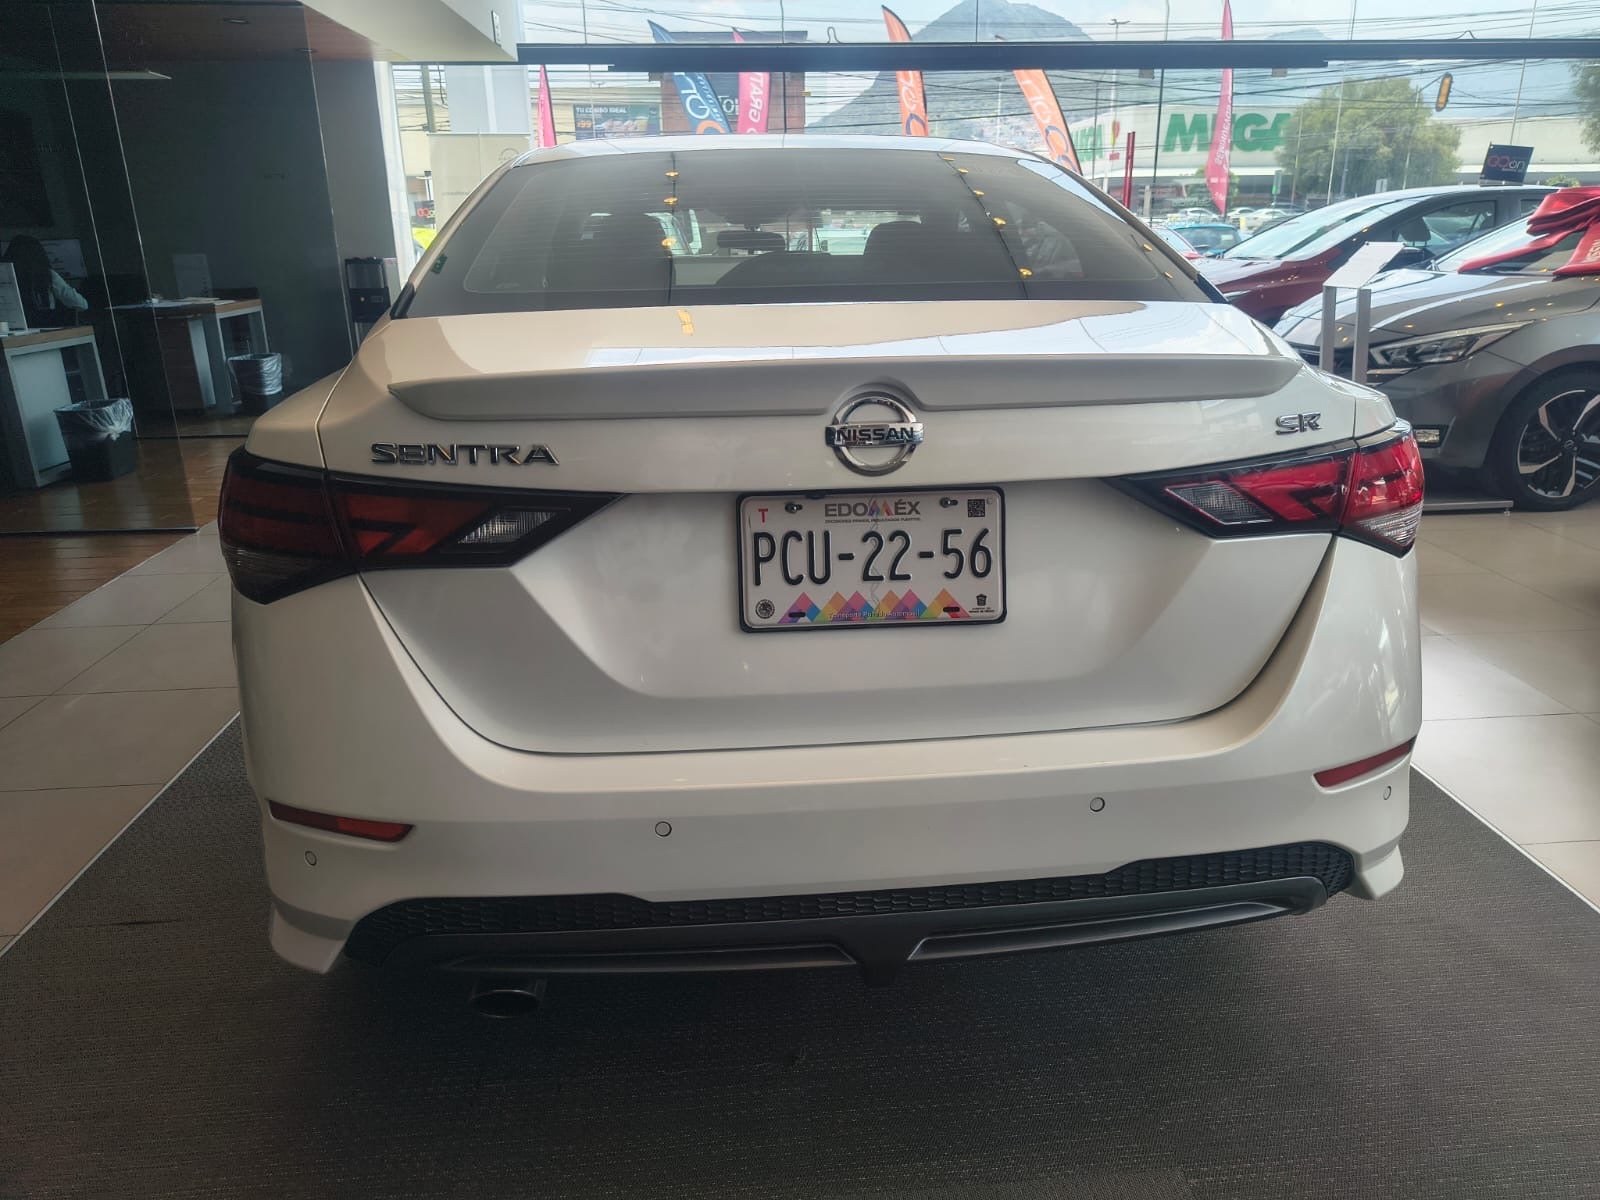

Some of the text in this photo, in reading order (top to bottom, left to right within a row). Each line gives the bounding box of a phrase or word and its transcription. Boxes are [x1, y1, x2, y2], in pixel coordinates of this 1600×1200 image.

[1162, 113, 1291, 152] MGA
[837, 427, 914, 442] NISSAN
[1276, 412, 1322, 435] SR
[371, 443, 559, 465] SENTRA
[758, 508, 769, 523] T
[753, 528, 992, 586] PCU-22-56
